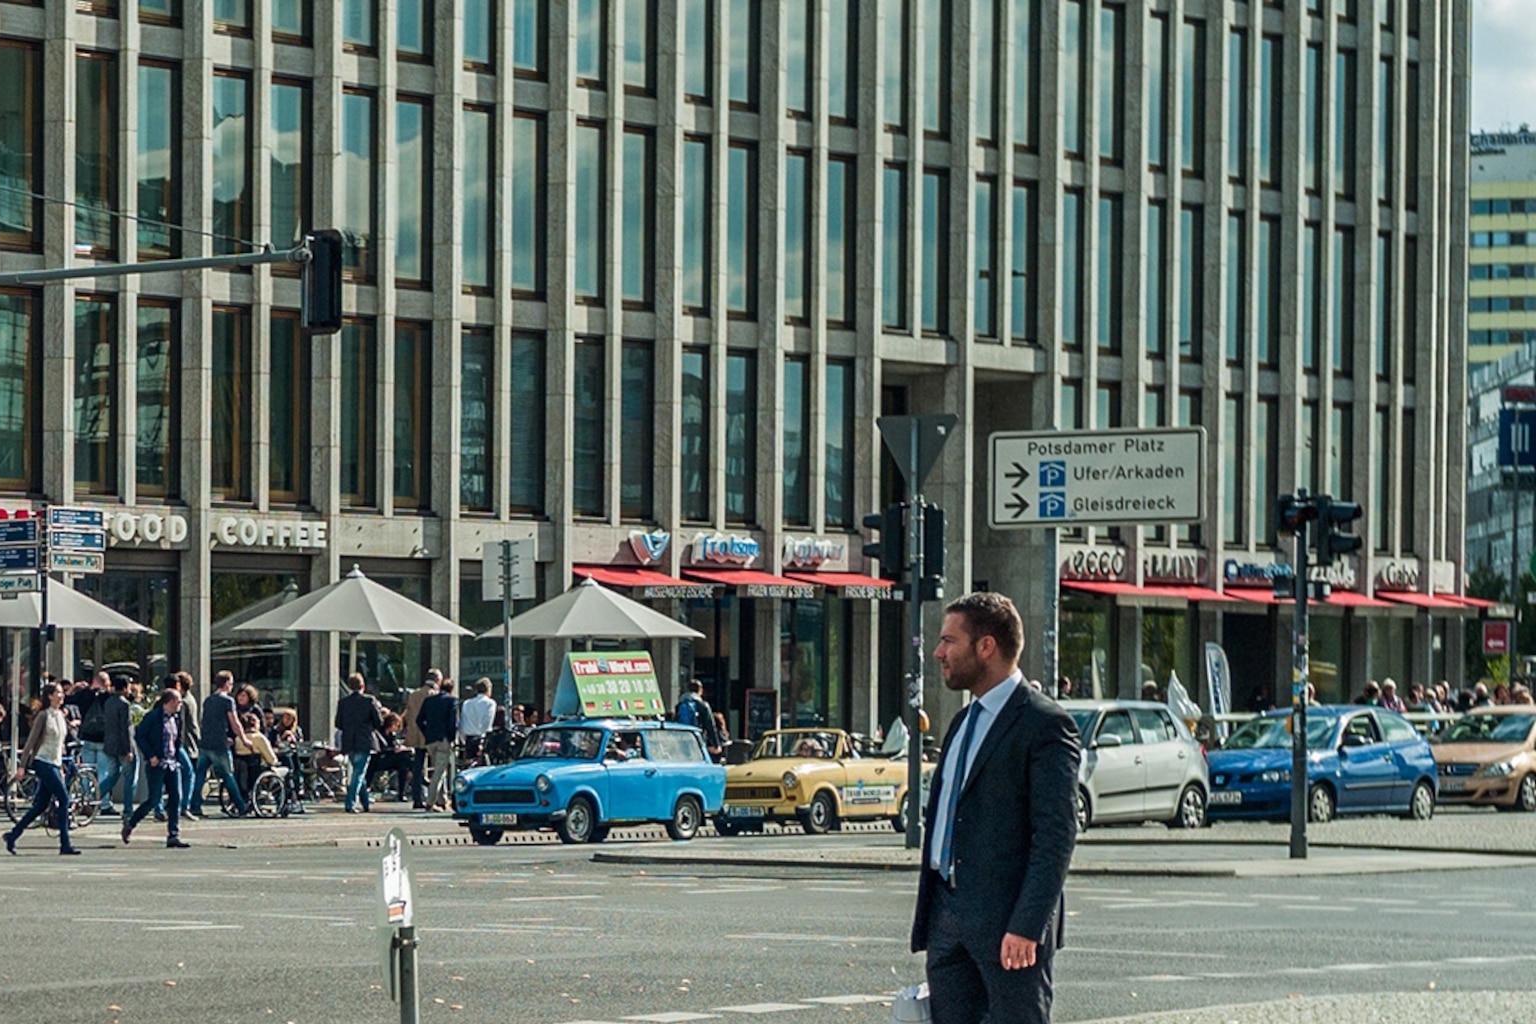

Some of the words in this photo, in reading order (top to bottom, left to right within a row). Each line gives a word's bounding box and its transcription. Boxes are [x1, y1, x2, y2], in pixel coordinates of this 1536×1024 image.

[1027, 440, 1116, 457] Potsdamer
[1124, 437, 1165, 454] Platz
[1072, 464, 1185, 482] Ufer/Arkaden
[1072, 495, 1176, 513] Gleisdreieck
[218, 516, 328, 548] COFFEE
